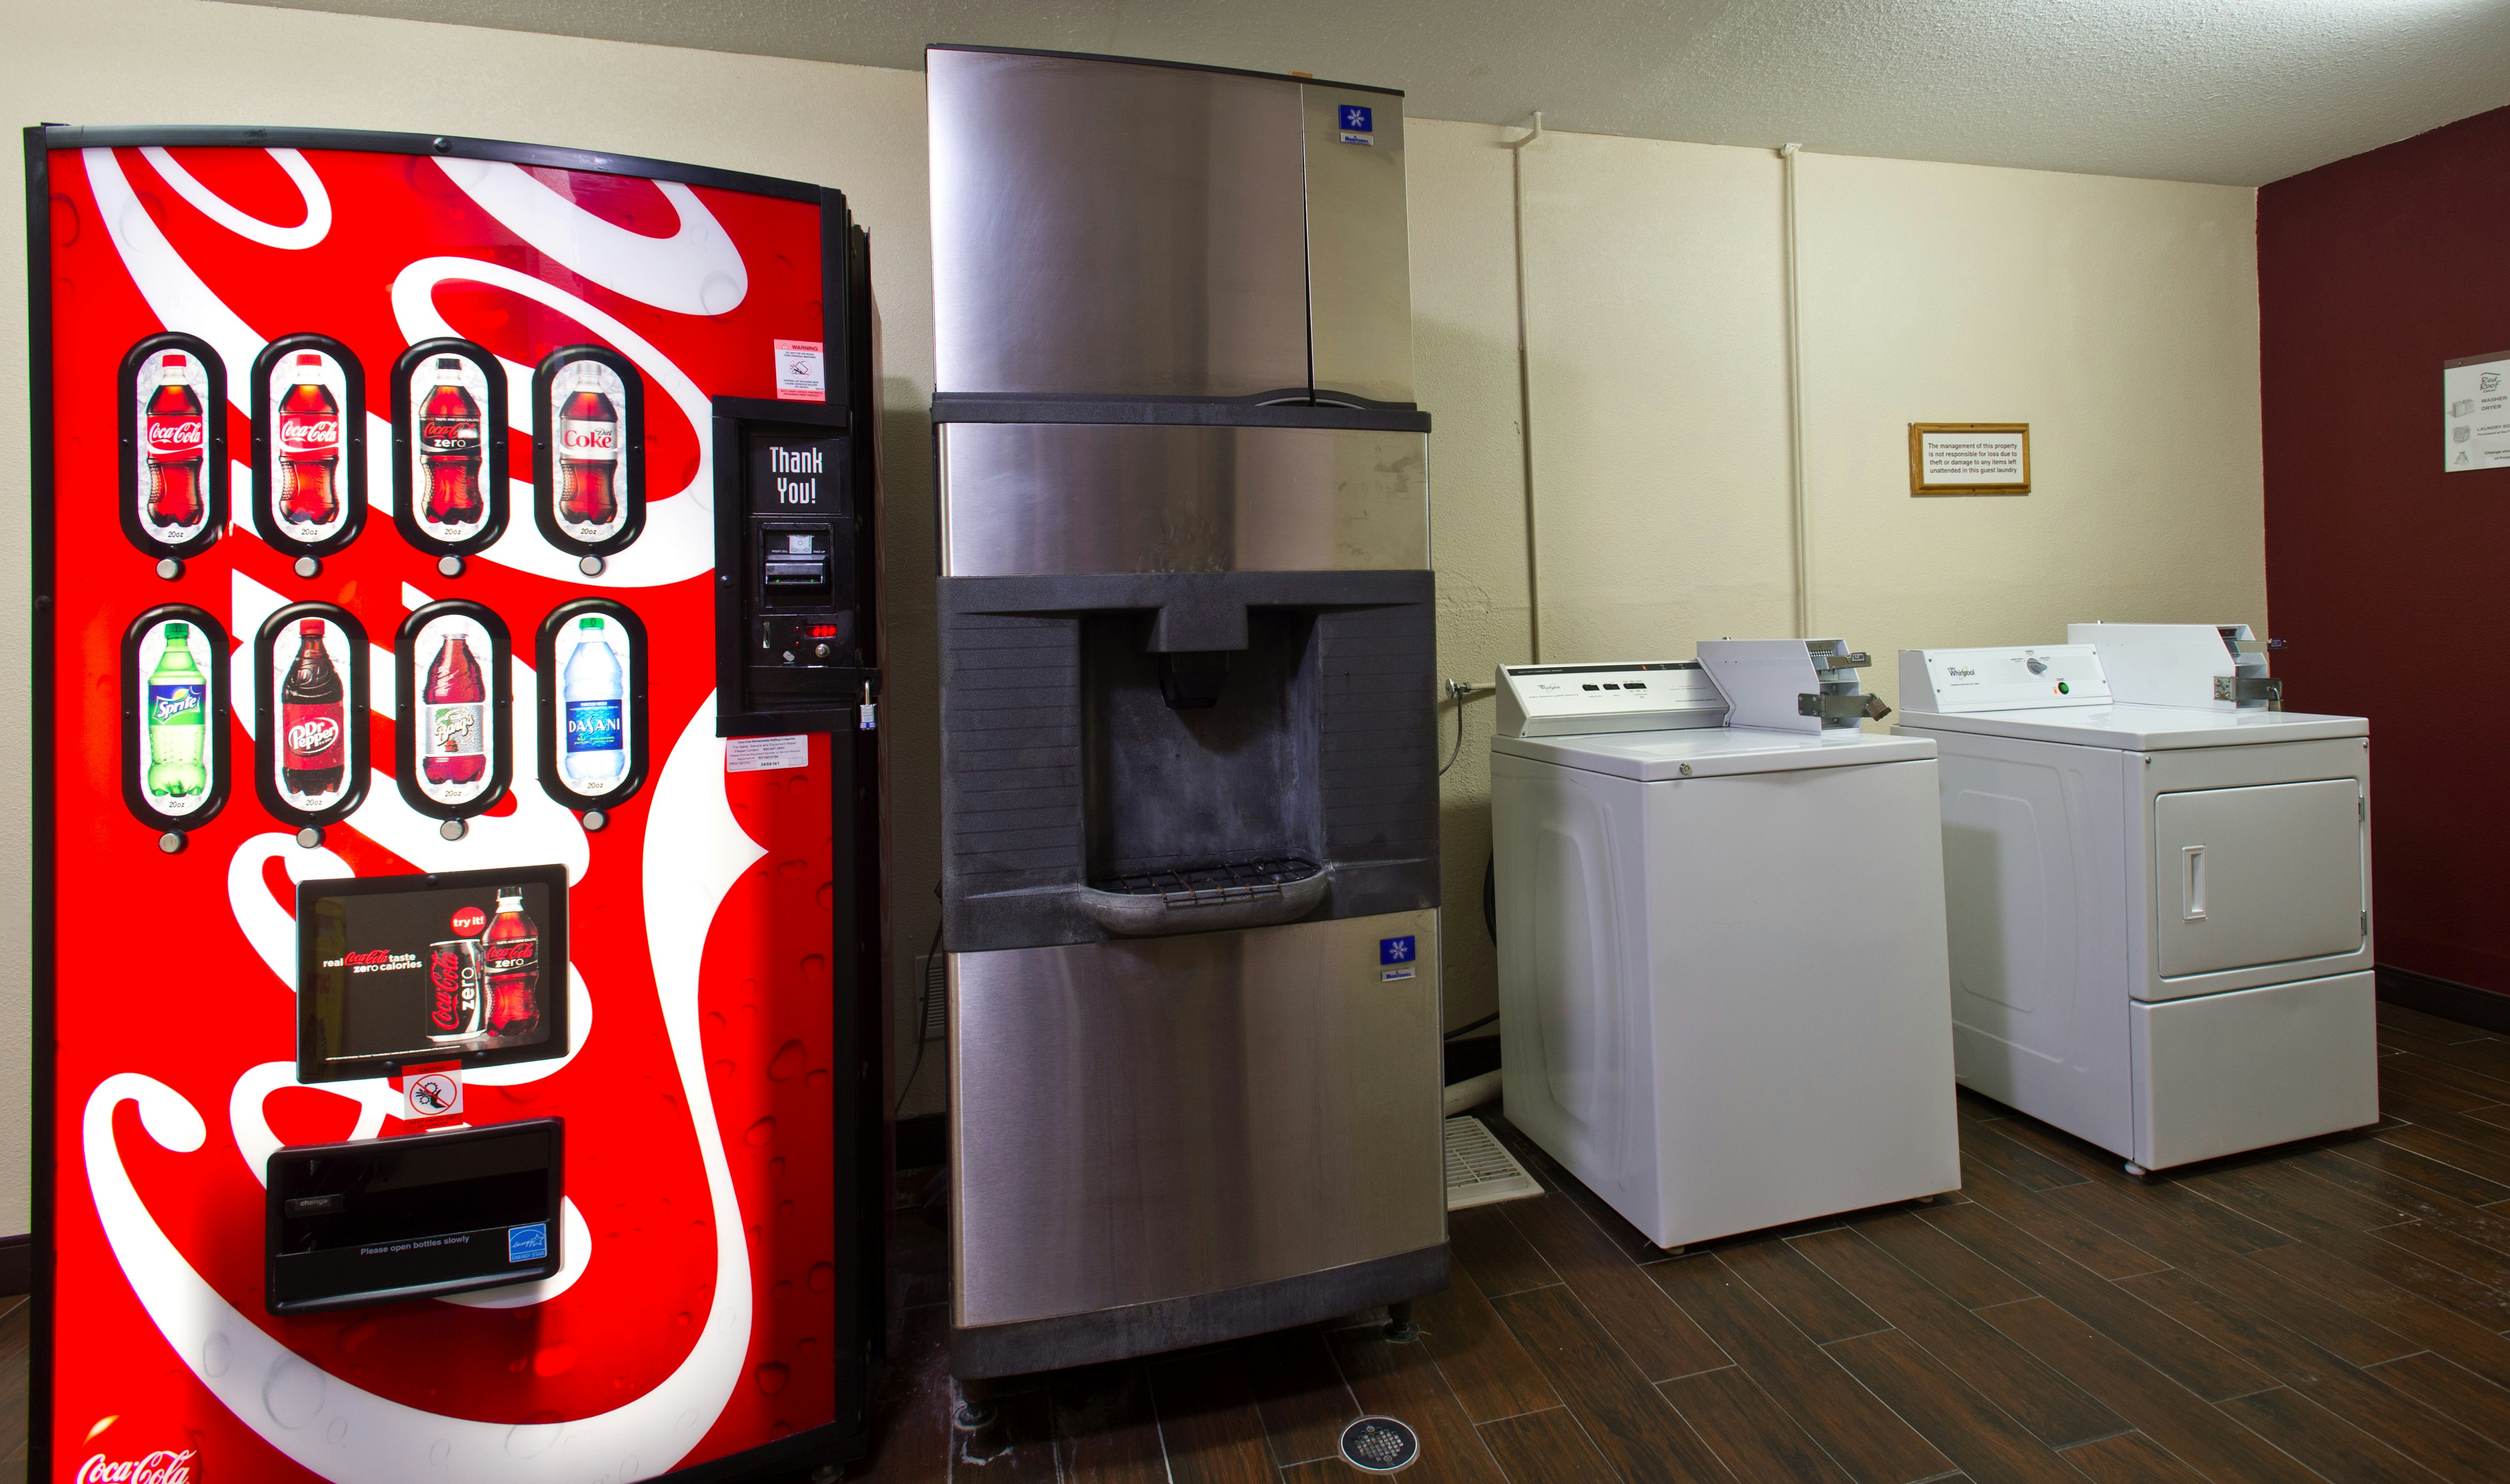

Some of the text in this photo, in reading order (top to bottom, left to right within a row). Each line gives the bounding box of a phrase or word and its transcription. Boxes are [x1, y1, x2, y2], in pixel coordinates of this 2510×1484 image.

[2480, 380, 2501, 391] Roof
[149, 422, 201, 443] Coca-Cola
[281, 420, 338, 442] Coca-Cola
[564, 430, 611, 448] Coke
[595, 428, 613, 436] Diet
[434, 439, 466, 447] zero
[769, 447, 823, 473] Thank
[777, 477, 816, 503] You!
[1947, 667, 1975, 677] Whirlpool
[157, 695, 197, 720] Sprite
[304, 722, 325, 737] Dr
[434, 715, 474, 746] Barq's
[569, 716, 620, 735] DASANI
[289, 725, 335, 750] Pepper
[453, 916, 484, 928] try it!
[323, 950, 416, 968] real Coca-Cola taste
[486, 943, 534, 961] Coca-Cola
[353, 961, 423, 973] zero calories
[495, 958, 524, 968] zero
[431, 950, 460, 1030] Coca-Cola
[461, 967, 475, 1011] zero
[300, 1198, 328, 1207] change
[361, 1235, 470, 1255] Please open bottles slowly
[76, 1449, 197, 1484] Coca-Cola
